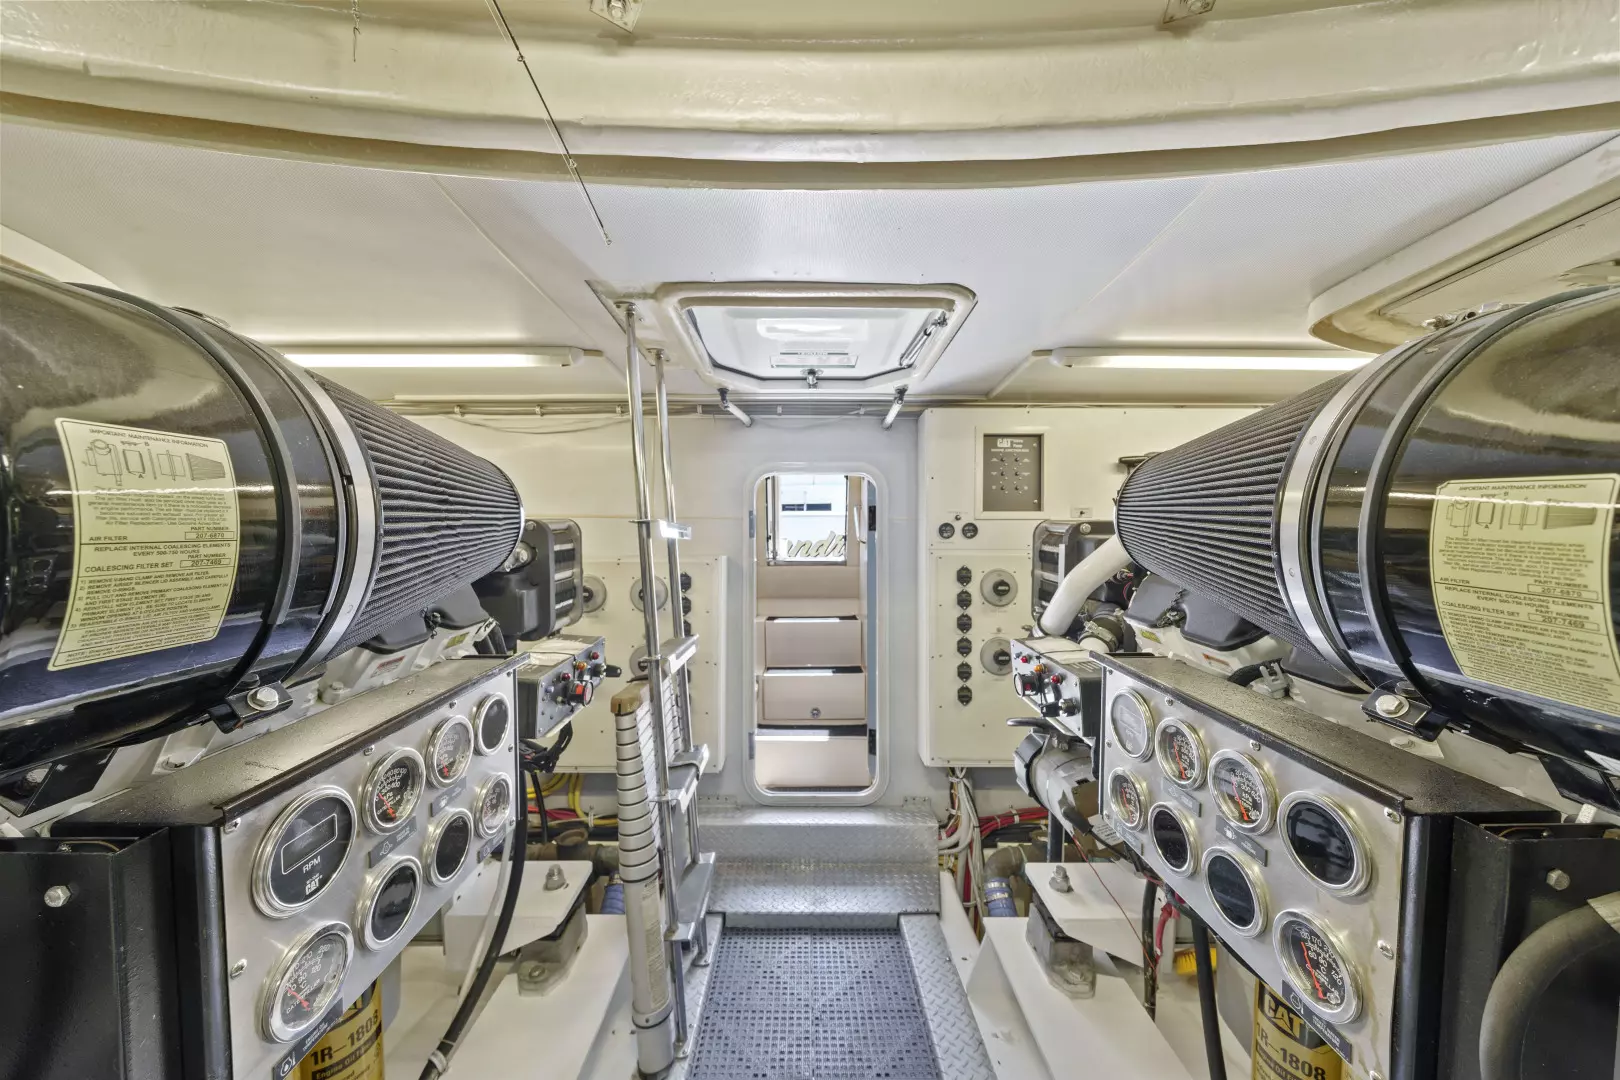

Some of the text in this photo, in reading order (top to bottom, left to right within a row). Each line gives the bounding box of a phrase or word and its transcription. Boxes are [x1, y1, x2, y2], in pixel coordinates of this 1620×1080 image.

[172, 439, 208, 448] INFORMATION
[997, 438, 1010, 448] CAT
[1441, 601, 1481, 612] COALESCING
[1483, 607, 1505, 616] FILTER
[302, 856, 321, 874] RPM
[305, 879, 320, 895] CAT
[1264, 992, 1304, 1038] CAT
